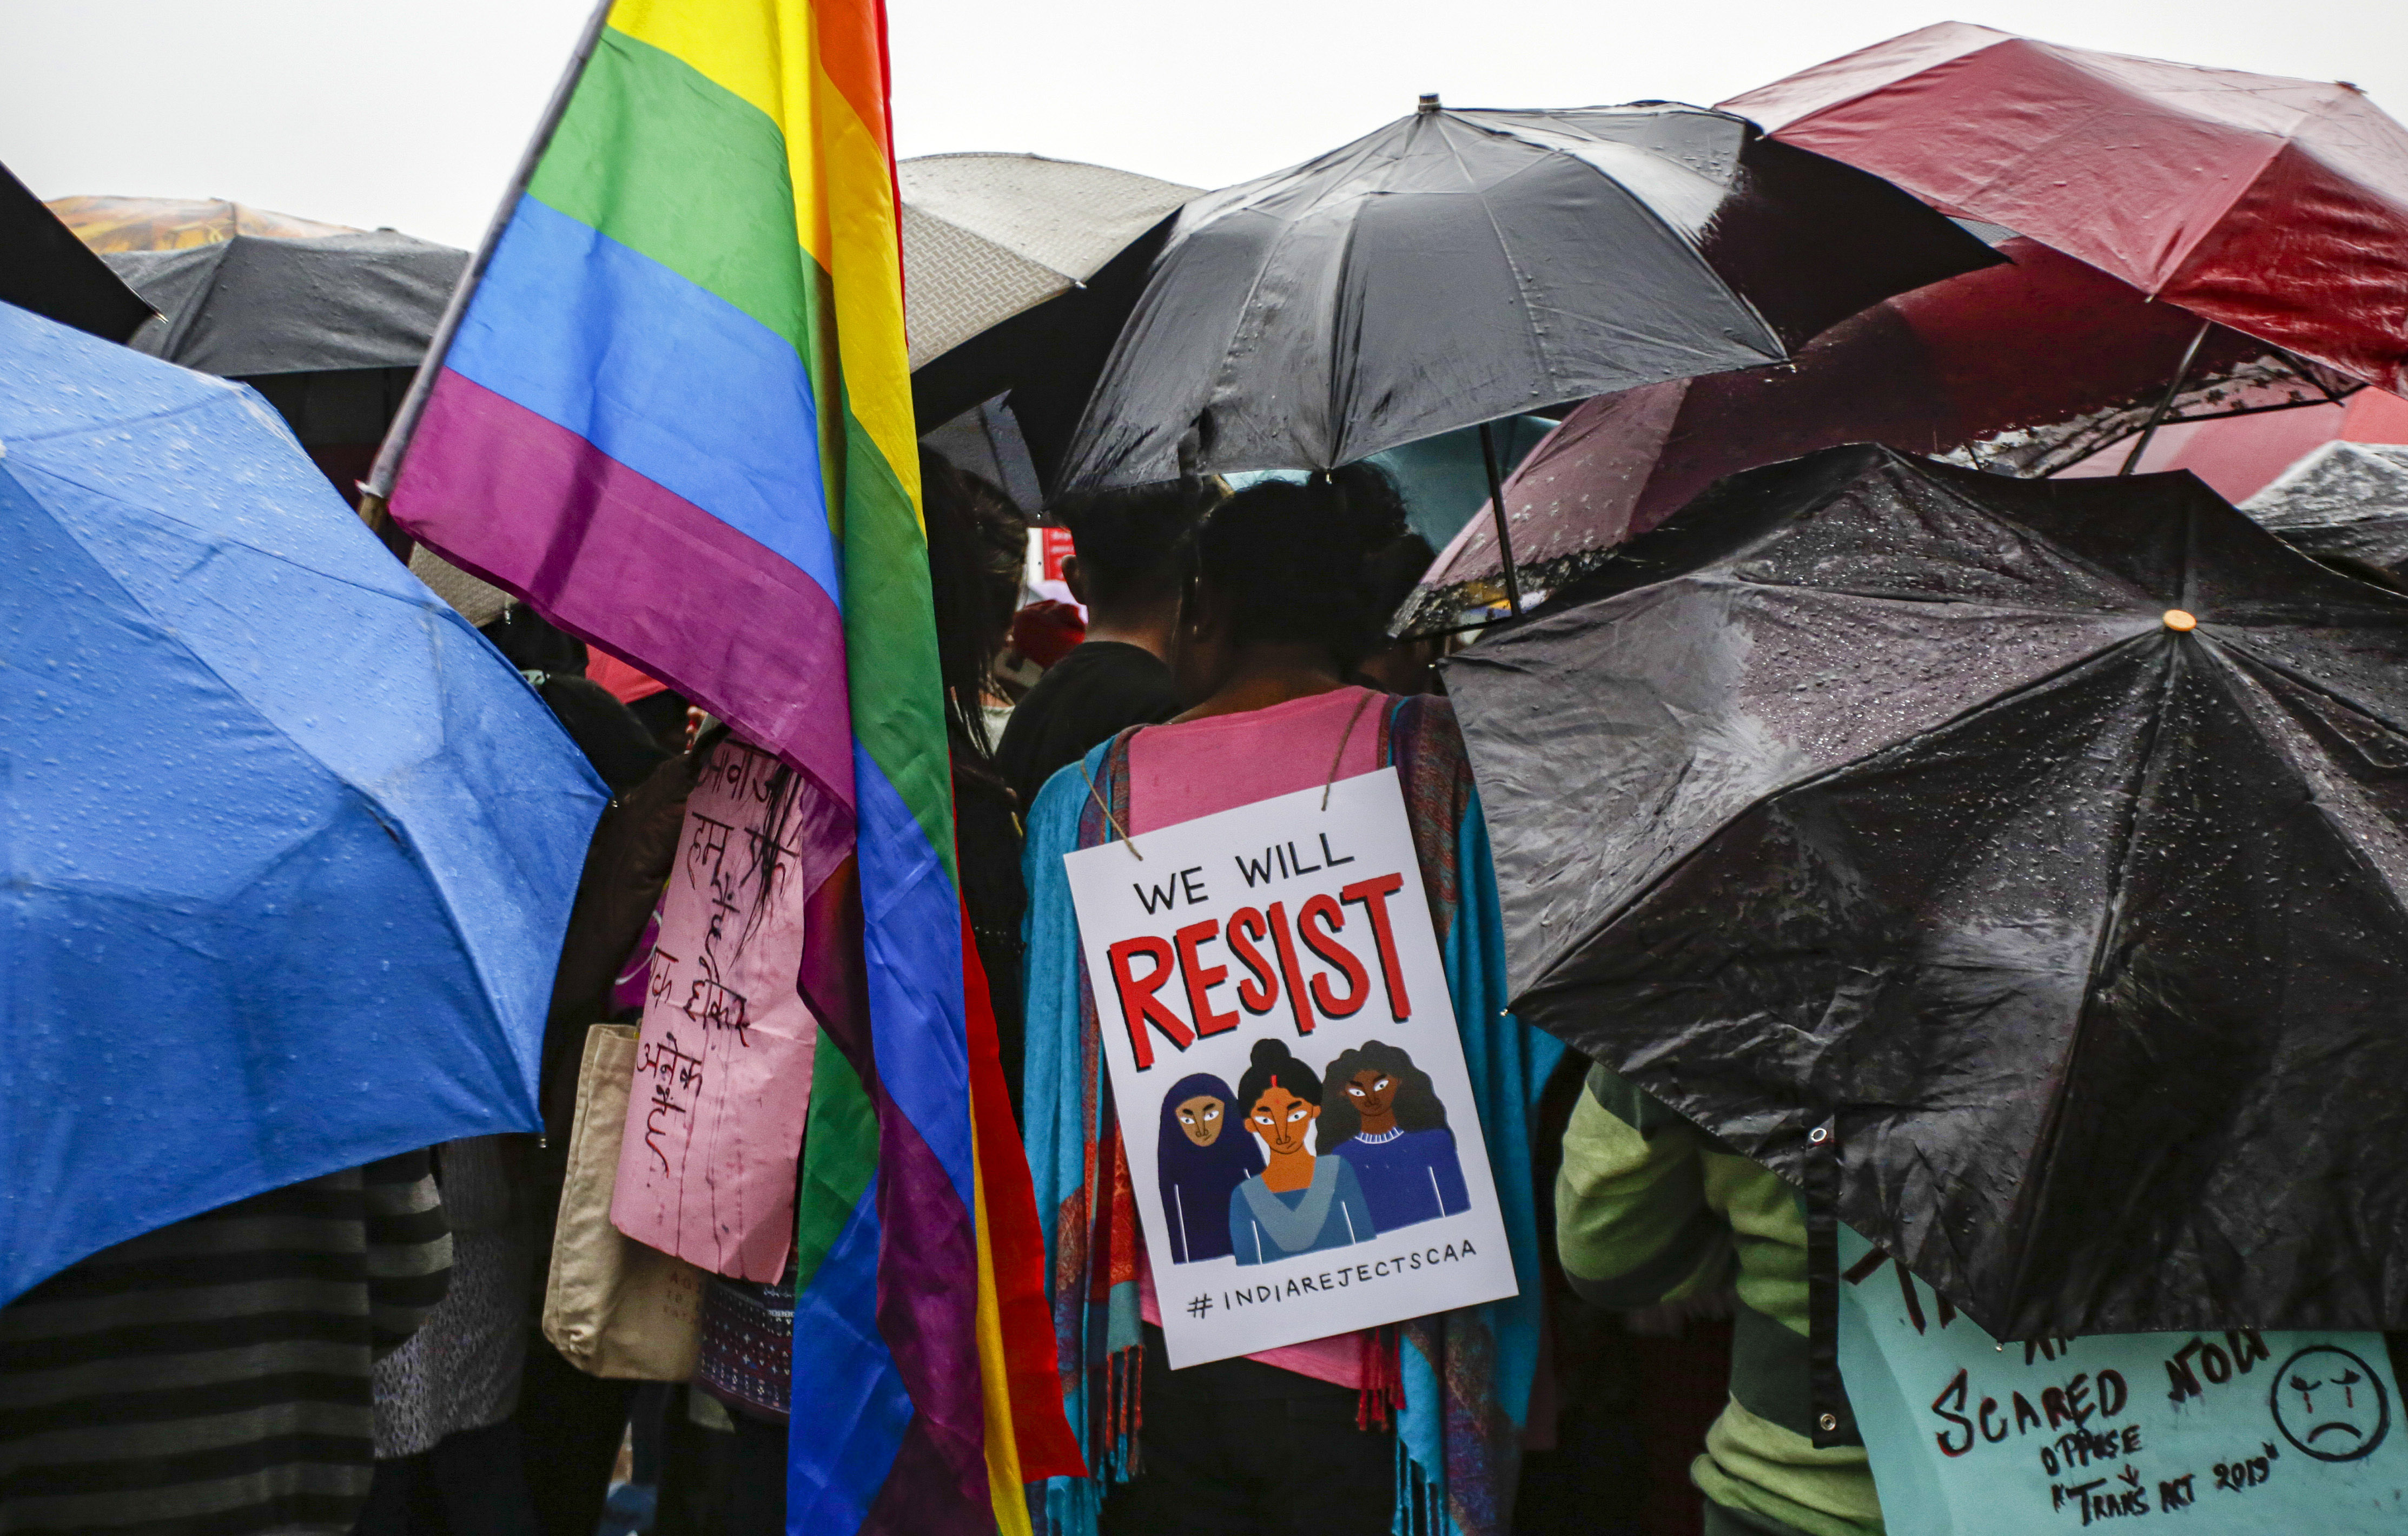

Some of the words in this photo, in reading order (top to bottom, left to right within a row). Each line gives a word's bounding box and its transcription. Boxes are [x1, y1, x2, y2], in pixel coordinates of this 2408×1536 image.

[1133, 866, 1209, 915] WE
[1235, 833, 1355, 888] WILL
[1107, 873, 1412, 1072] RESIST
[1187, 1240, 1476, 1319] #INDIAREJECTSCAA
[1931, 1368, 2128, 1457] SCARED
